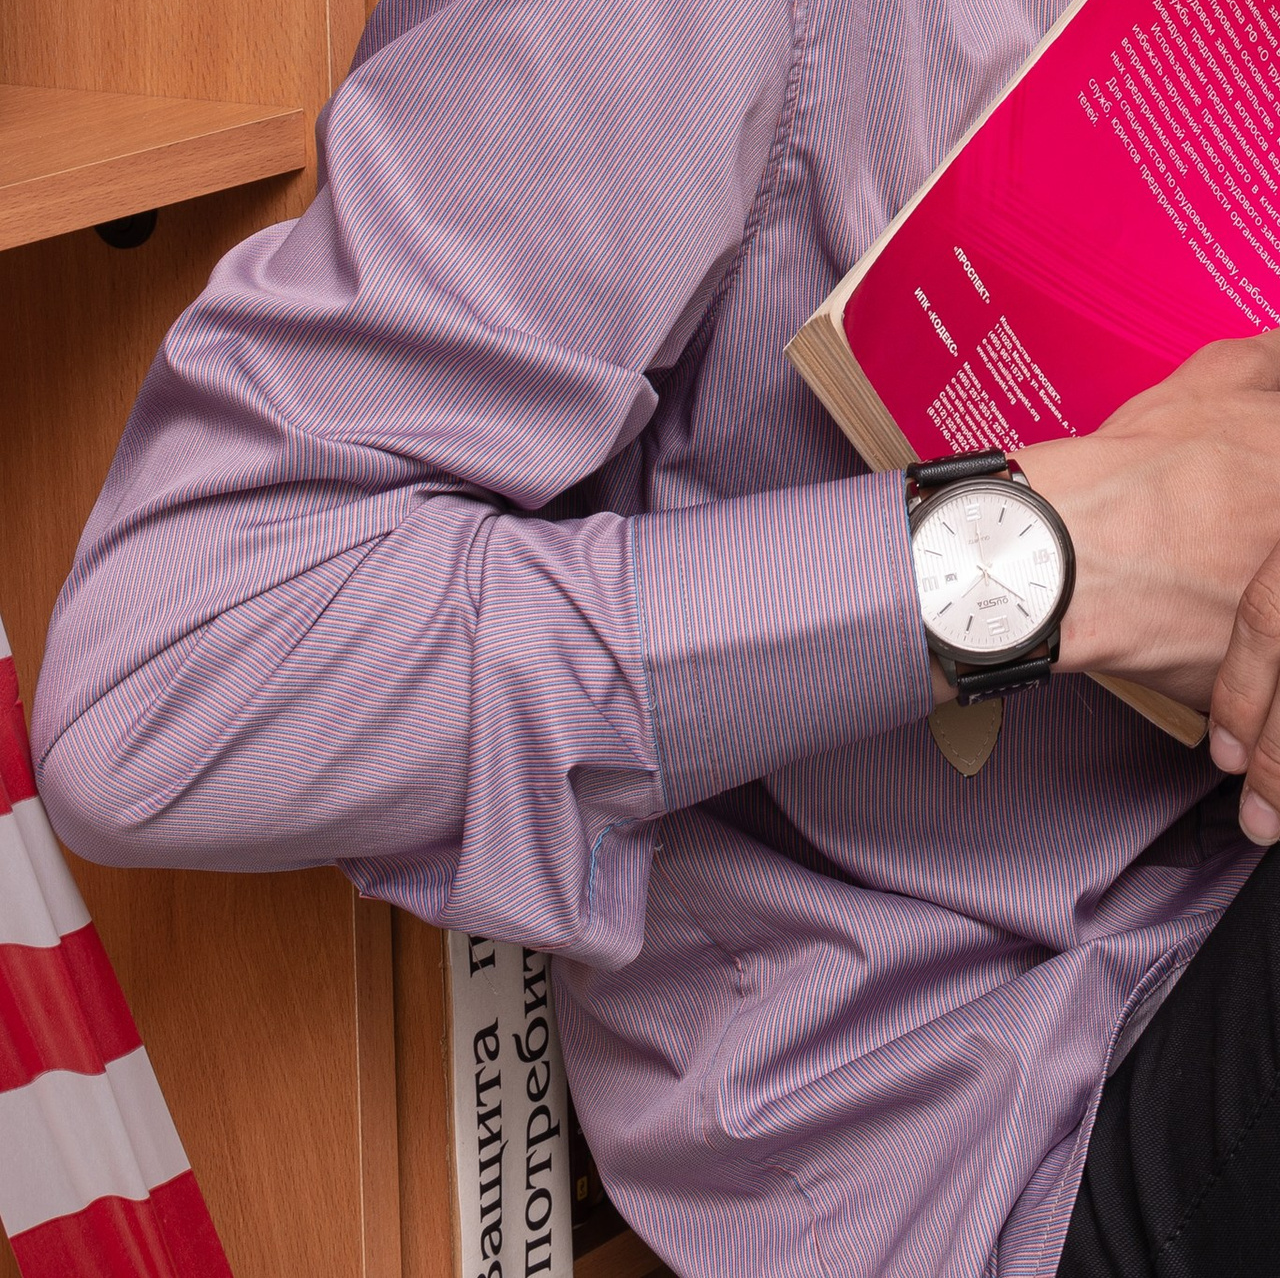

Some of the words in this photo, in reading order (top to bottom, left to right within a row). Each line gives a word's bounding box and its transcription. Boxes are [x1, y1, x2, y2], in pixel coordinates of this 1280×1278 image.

[1077, 90, 1100, 128] телей.
[953, 245, 991, 305] «ПРОСПЕКТ»
[913, 286, 931, 312] ИПК
[927, 310, 959, 358] «КОДЕКС»
[987, 330, 1003, 351] (495)
[975, 344, 1017, 406] www.prospekt.org
[994, 323, 1013, 354] 111020,
[1011, 350, 1031, 381] Москва,
[1029, 378, 1039, 390] ул.
[1035, 388, 1063, 422] Боровая,
[999, 314, 1032, 364] Издательство
[1030, 362, 1062, 405] «ПРОСПЕКТ»
[938, 391, 980, 452] Санкт-Петербург,
[996, 360, 1041, 423] mail@prospekt.org
